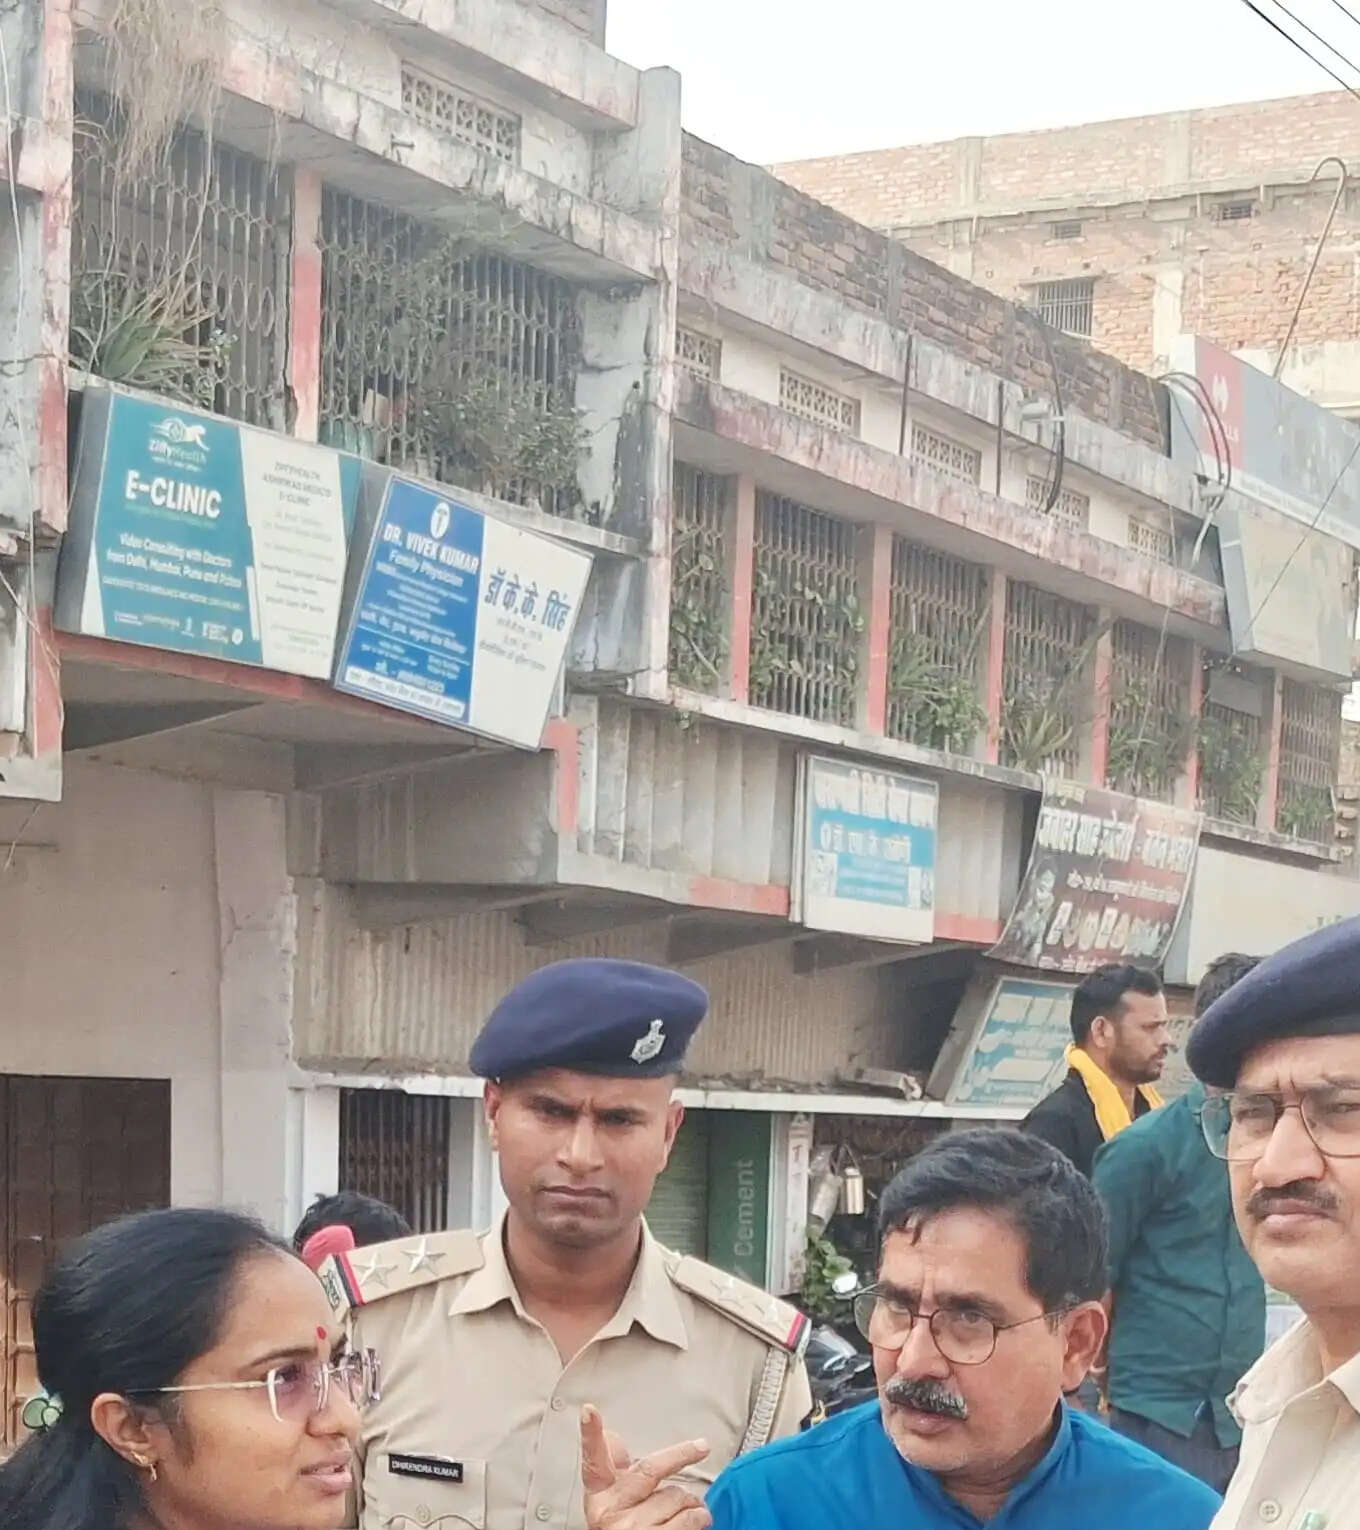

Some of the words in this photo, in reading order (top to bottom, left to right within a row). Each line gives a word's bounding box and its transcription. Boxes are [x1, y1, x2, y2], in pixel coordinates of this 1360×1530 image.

[125, 469, 222, 518] E-CLINIC
[383, 522, 402, 546] DR.
[406, 531, 440, 560] VIVEK
[439, 545, 480, 575] KUMAR
[540, 590, 572, 631] सिंह
[733, 1159, 755, 1256] Cement
[433, 1466, 459, 1478] KUMAR
